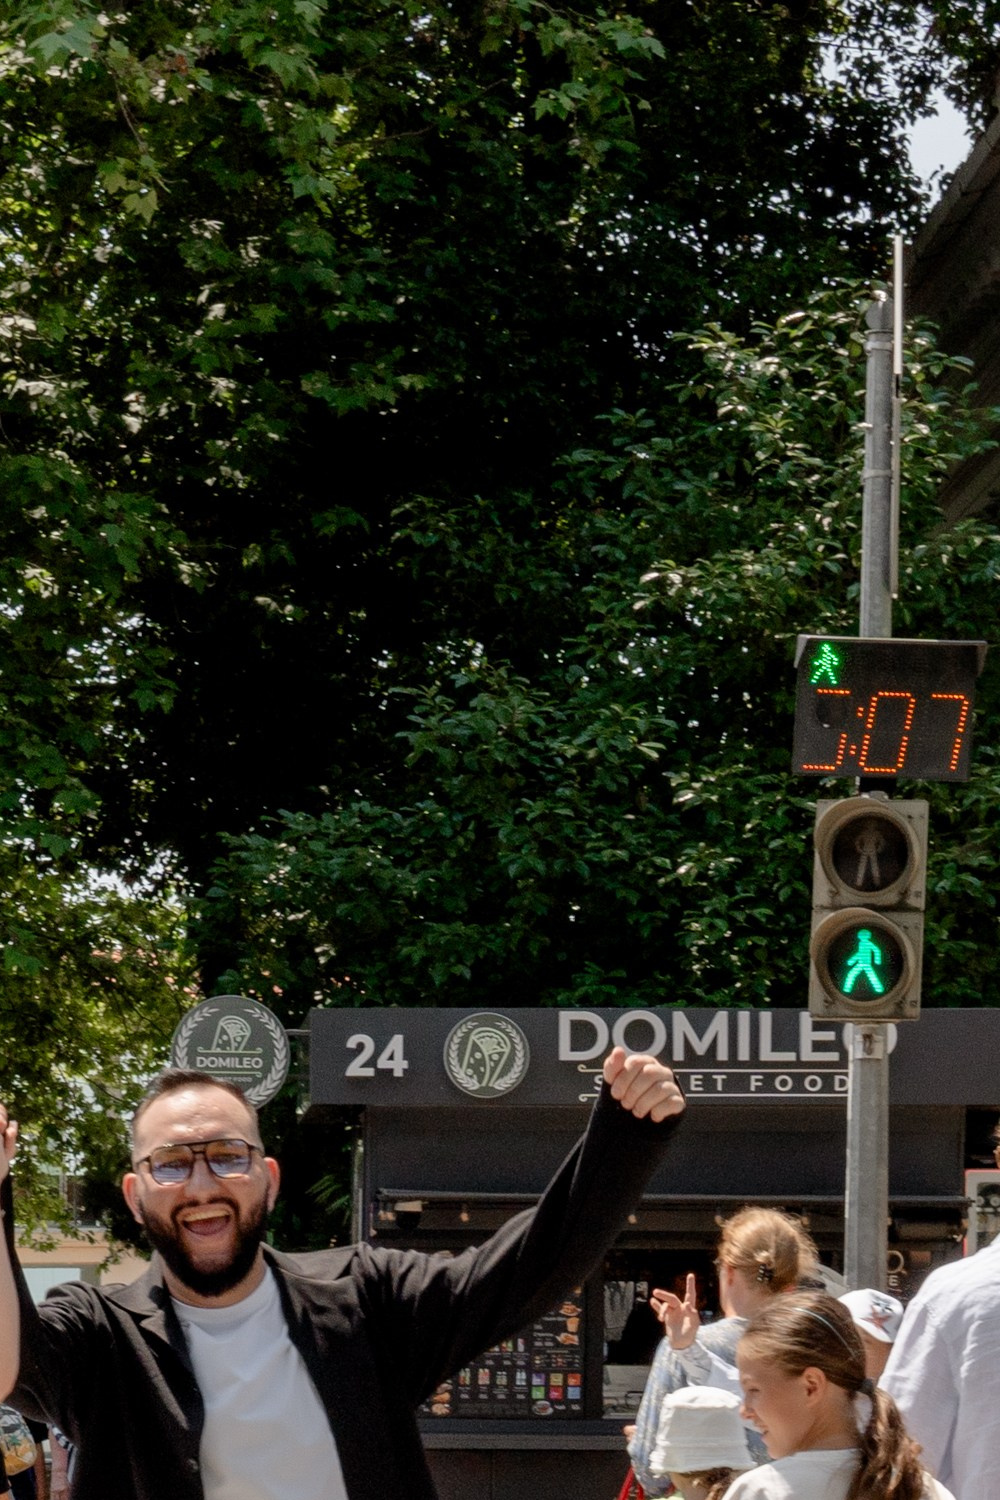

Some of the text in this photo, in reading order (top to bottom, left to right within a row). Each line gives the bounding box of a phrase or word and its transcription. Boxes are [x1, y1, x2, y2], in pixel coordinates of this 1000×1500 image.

[196, 1056, 263, 1069] DOMILEO
[345, 1033, 409, 1077] 24
[750, 1075, 849, 1092] FOOD
